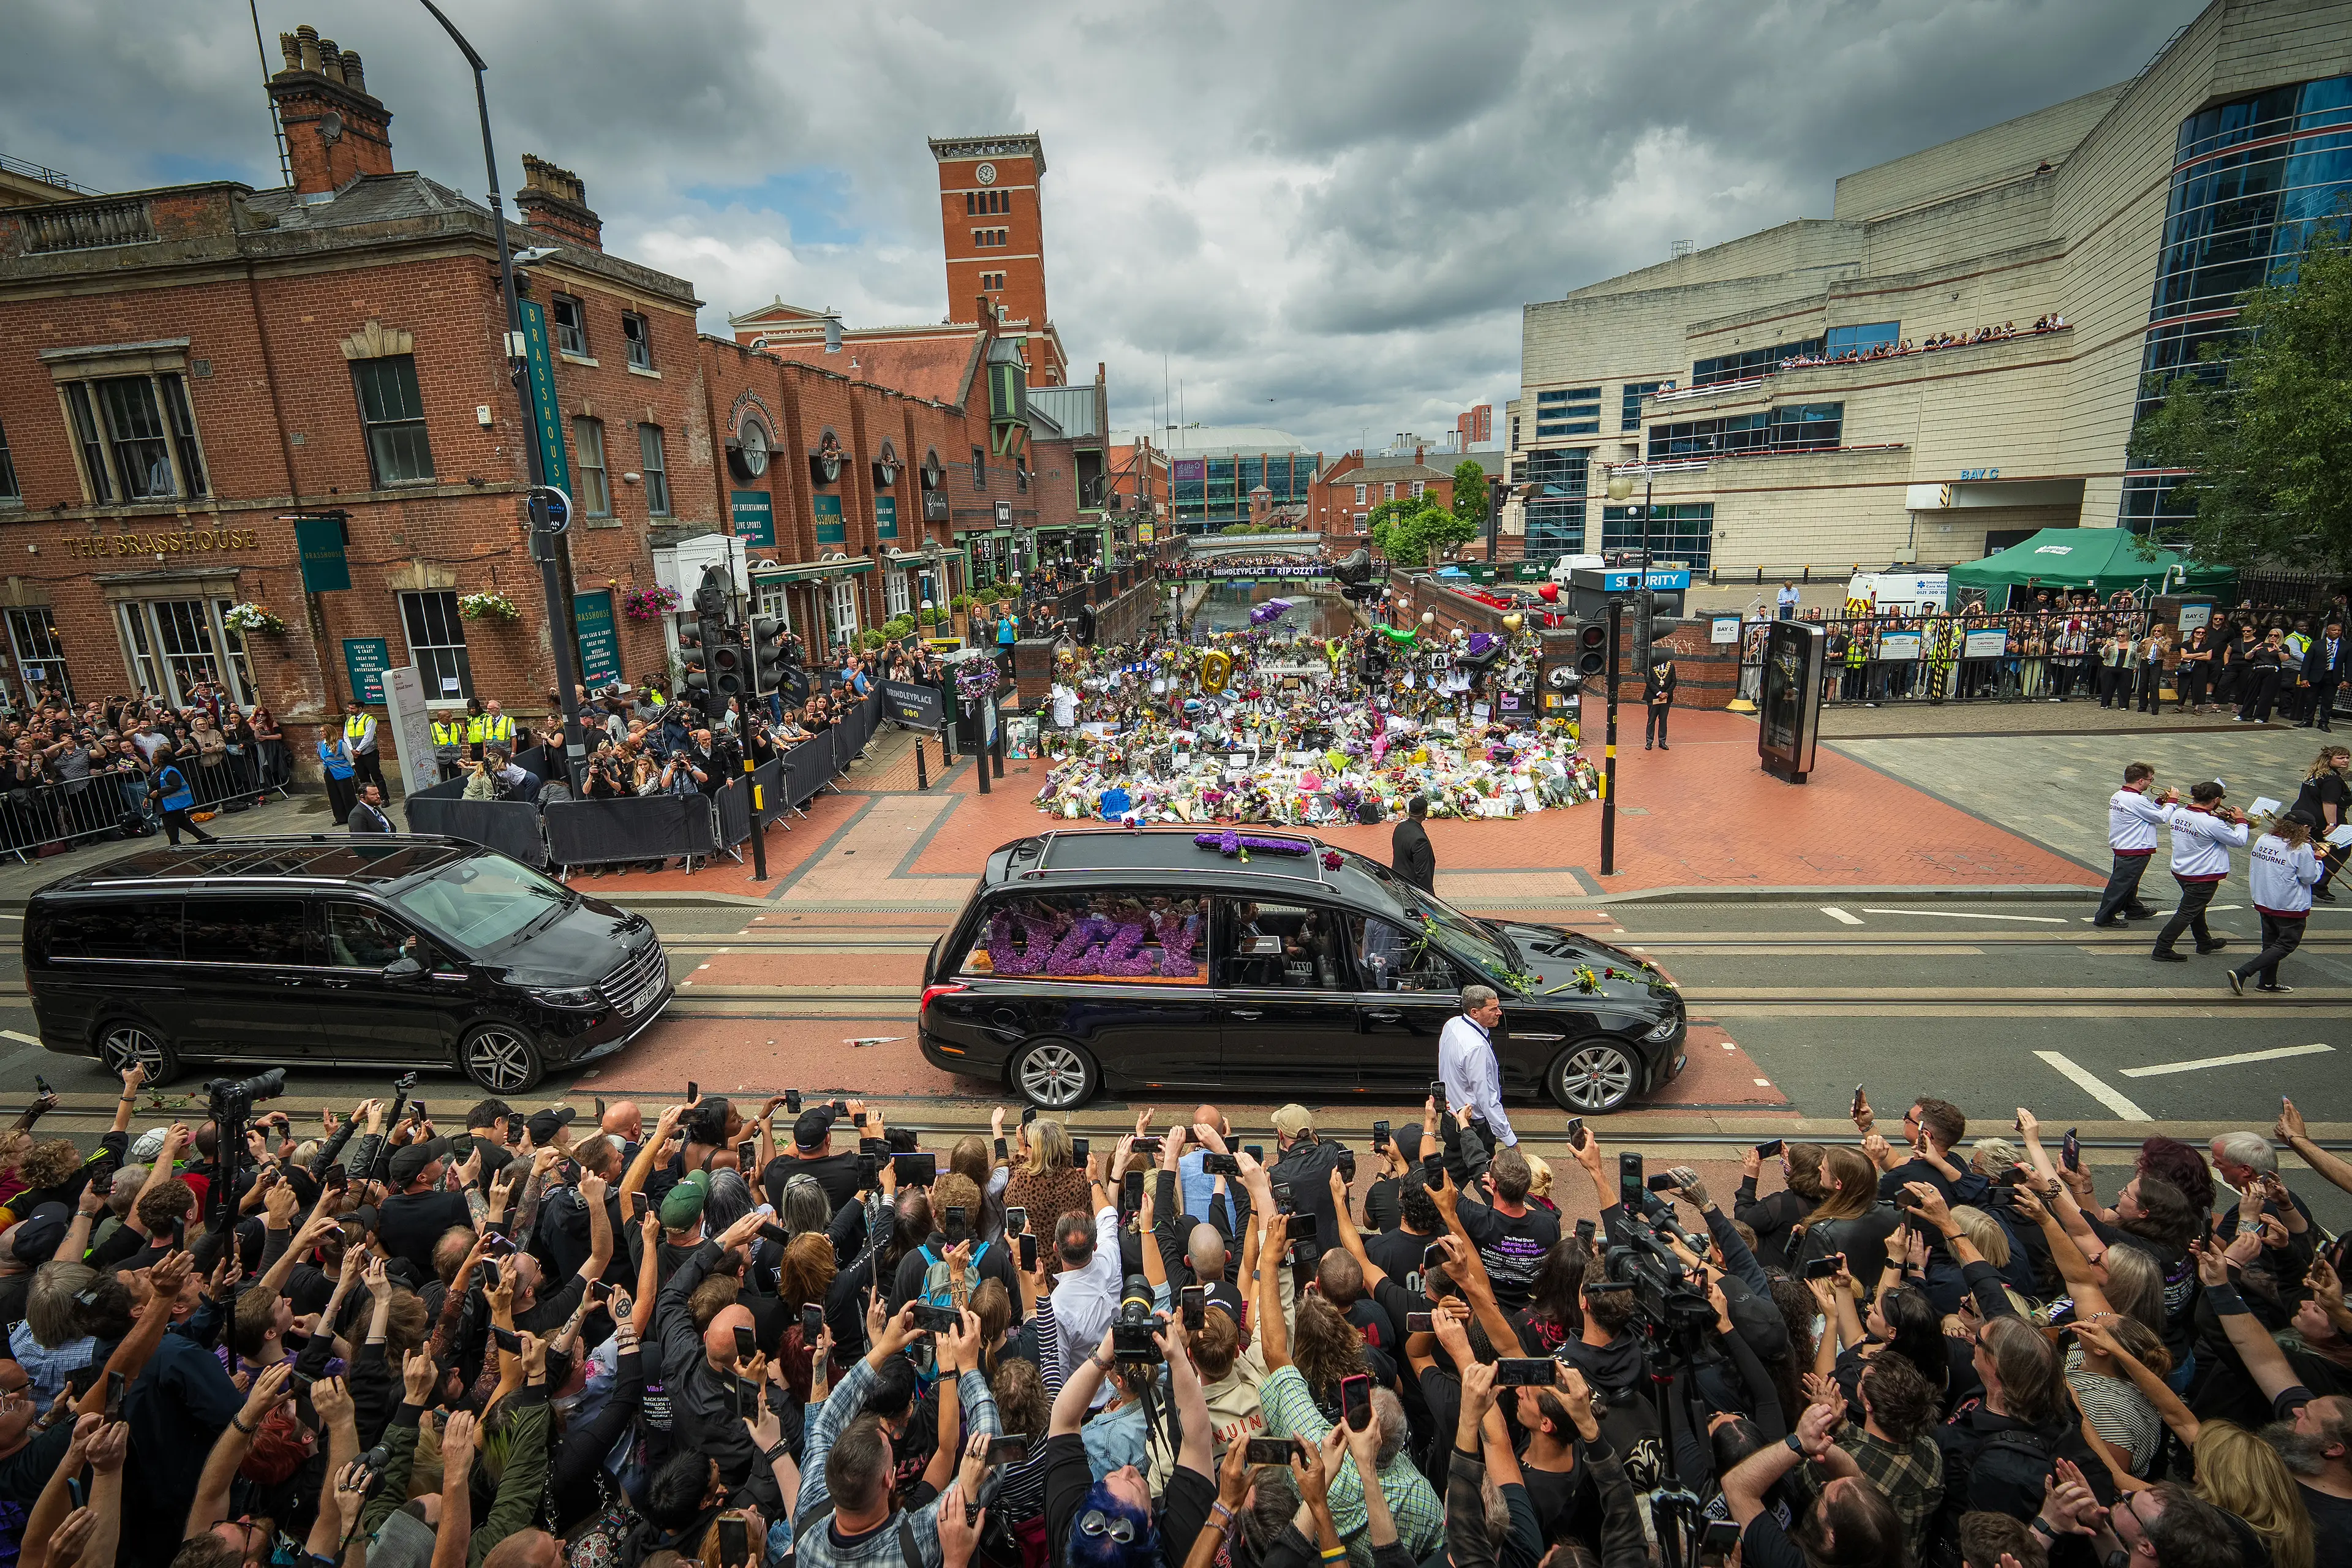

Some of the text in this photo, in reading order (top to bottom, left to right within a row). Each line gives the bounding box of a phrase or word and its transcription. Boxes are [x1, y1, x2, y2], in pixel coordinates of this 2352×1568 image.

[728, 388, 779, 436] Celebrity Restaurant
[1961, 467, 1999, 480] BAY C
[926, 492, 946, 516] Celebrity
[998, 508, 1009, 520] BOX
[62, 529, 258, 557] THE BRASSHOUSE
[305, 551, 342, 559] BRASSHOUSE
[798, 571, 822, 580] TRADITIONAL
[585, 651, 611, 661] ENTERTAINMENT
[886, 688, 932, 705] BRINDLEYPLACE
[896, 701, 924, 710] brindleyplace.com
[2175, 818, 2192, 827] OZZY
[2258, 846, 2279, 856] OZZY
[2252, 851, 2286, 866] OSBOURNE
[639, 983, 657, 1005] C2 RDN
[1481, 1251, 1502, 1262] METALLICA
[1482, 1247, 1496, 1256] BLACK
